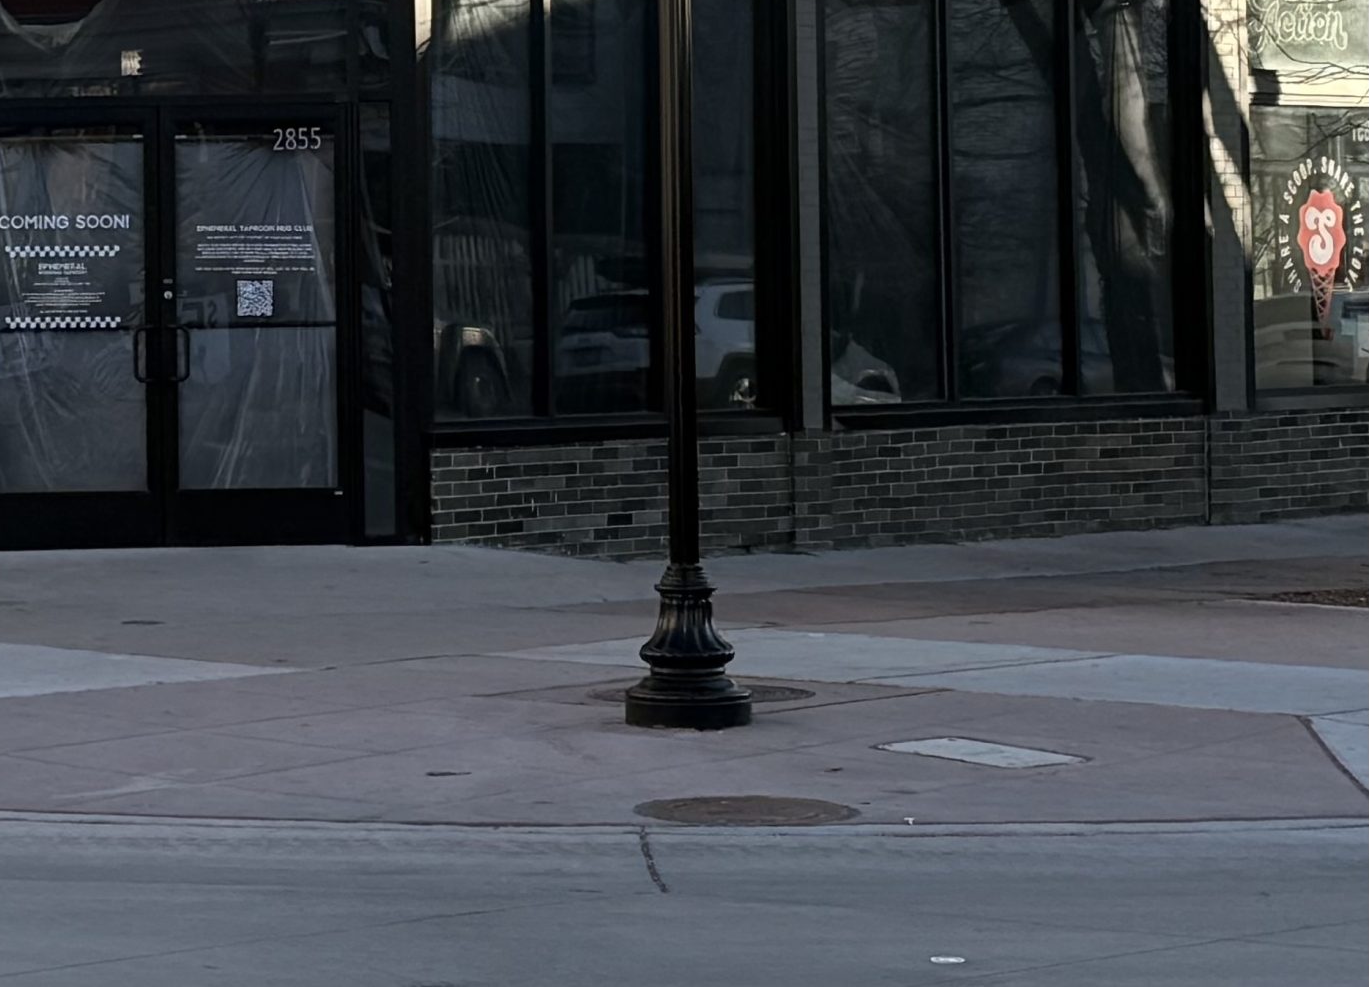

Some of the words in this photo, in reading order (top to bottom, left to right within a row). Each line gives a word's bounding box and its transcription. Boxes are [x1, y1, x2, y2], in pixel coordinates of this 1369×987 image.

[1248, 0, 1348, 53] Action
[273, 127, 321, 150] 2855
[1321, 156, 1355, 197] SHARE
[1278, 213, 1290, 225] A
[1350, 200, 1364, 237] THE
[1279, 234, 1302, 293] SHARE
